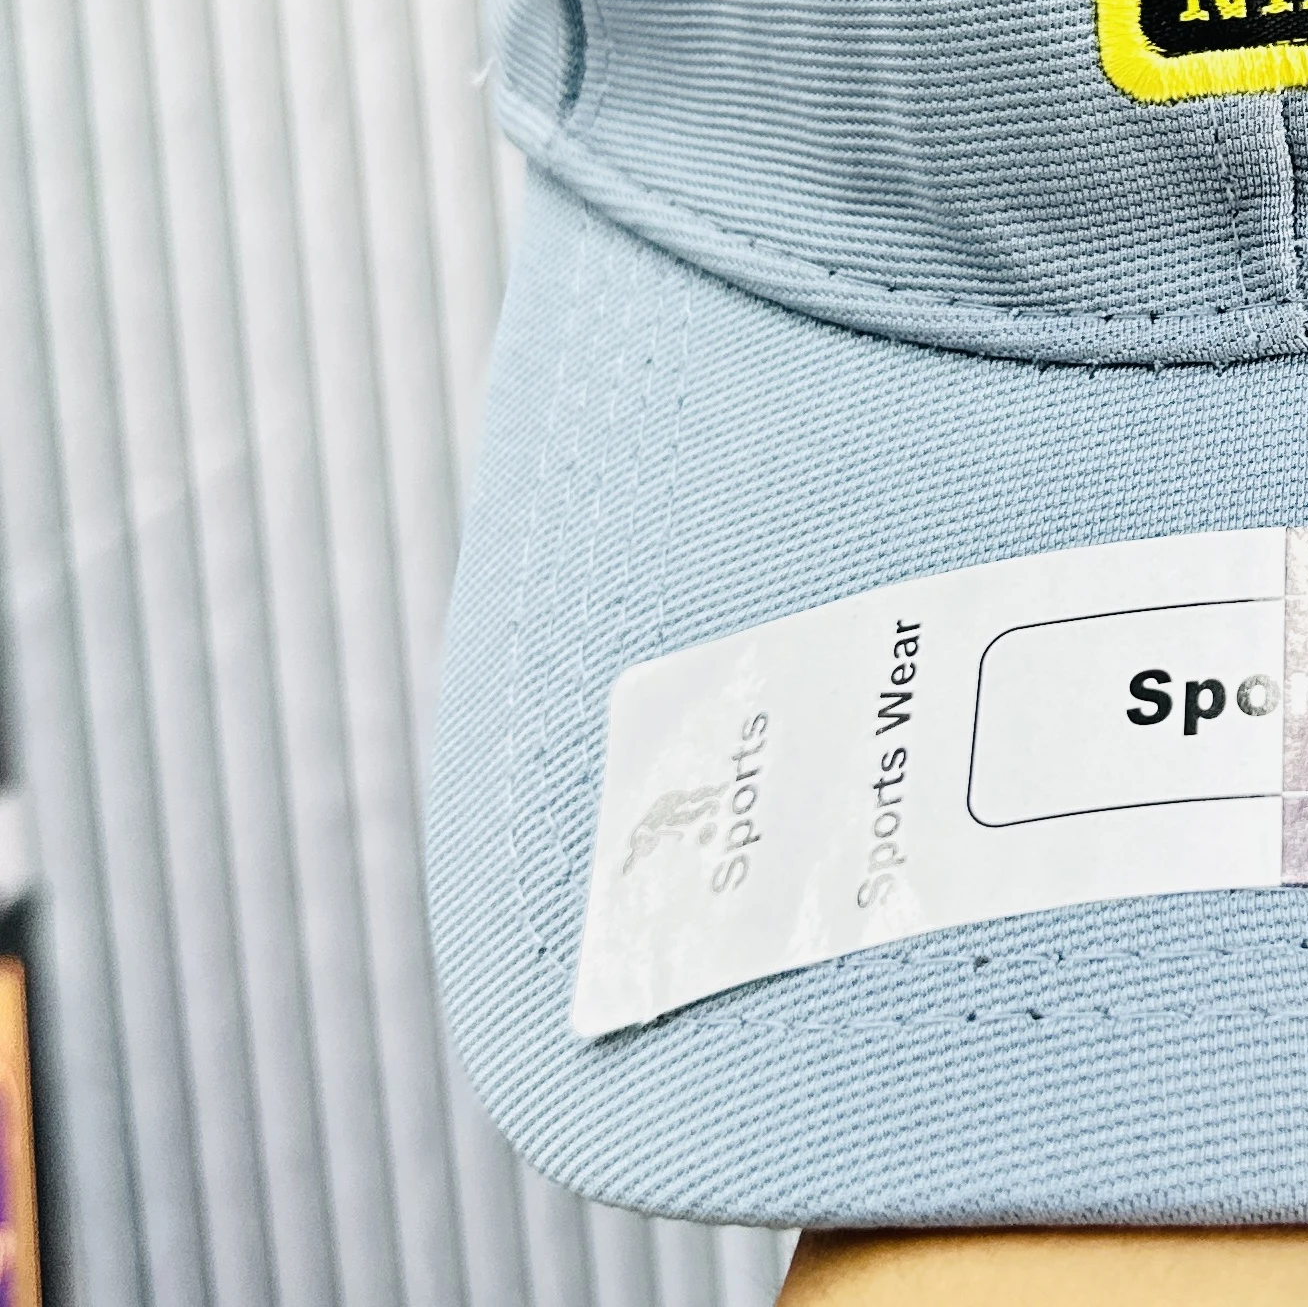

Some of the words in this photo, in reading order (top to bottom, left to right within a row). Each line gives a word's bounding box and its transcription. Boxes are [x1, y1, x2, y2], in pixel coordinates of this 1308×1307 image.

[875, 619, 921, 736] Wear
[712, 712, 768, 895] Sports
[858, 747, 908, 910] Sports
